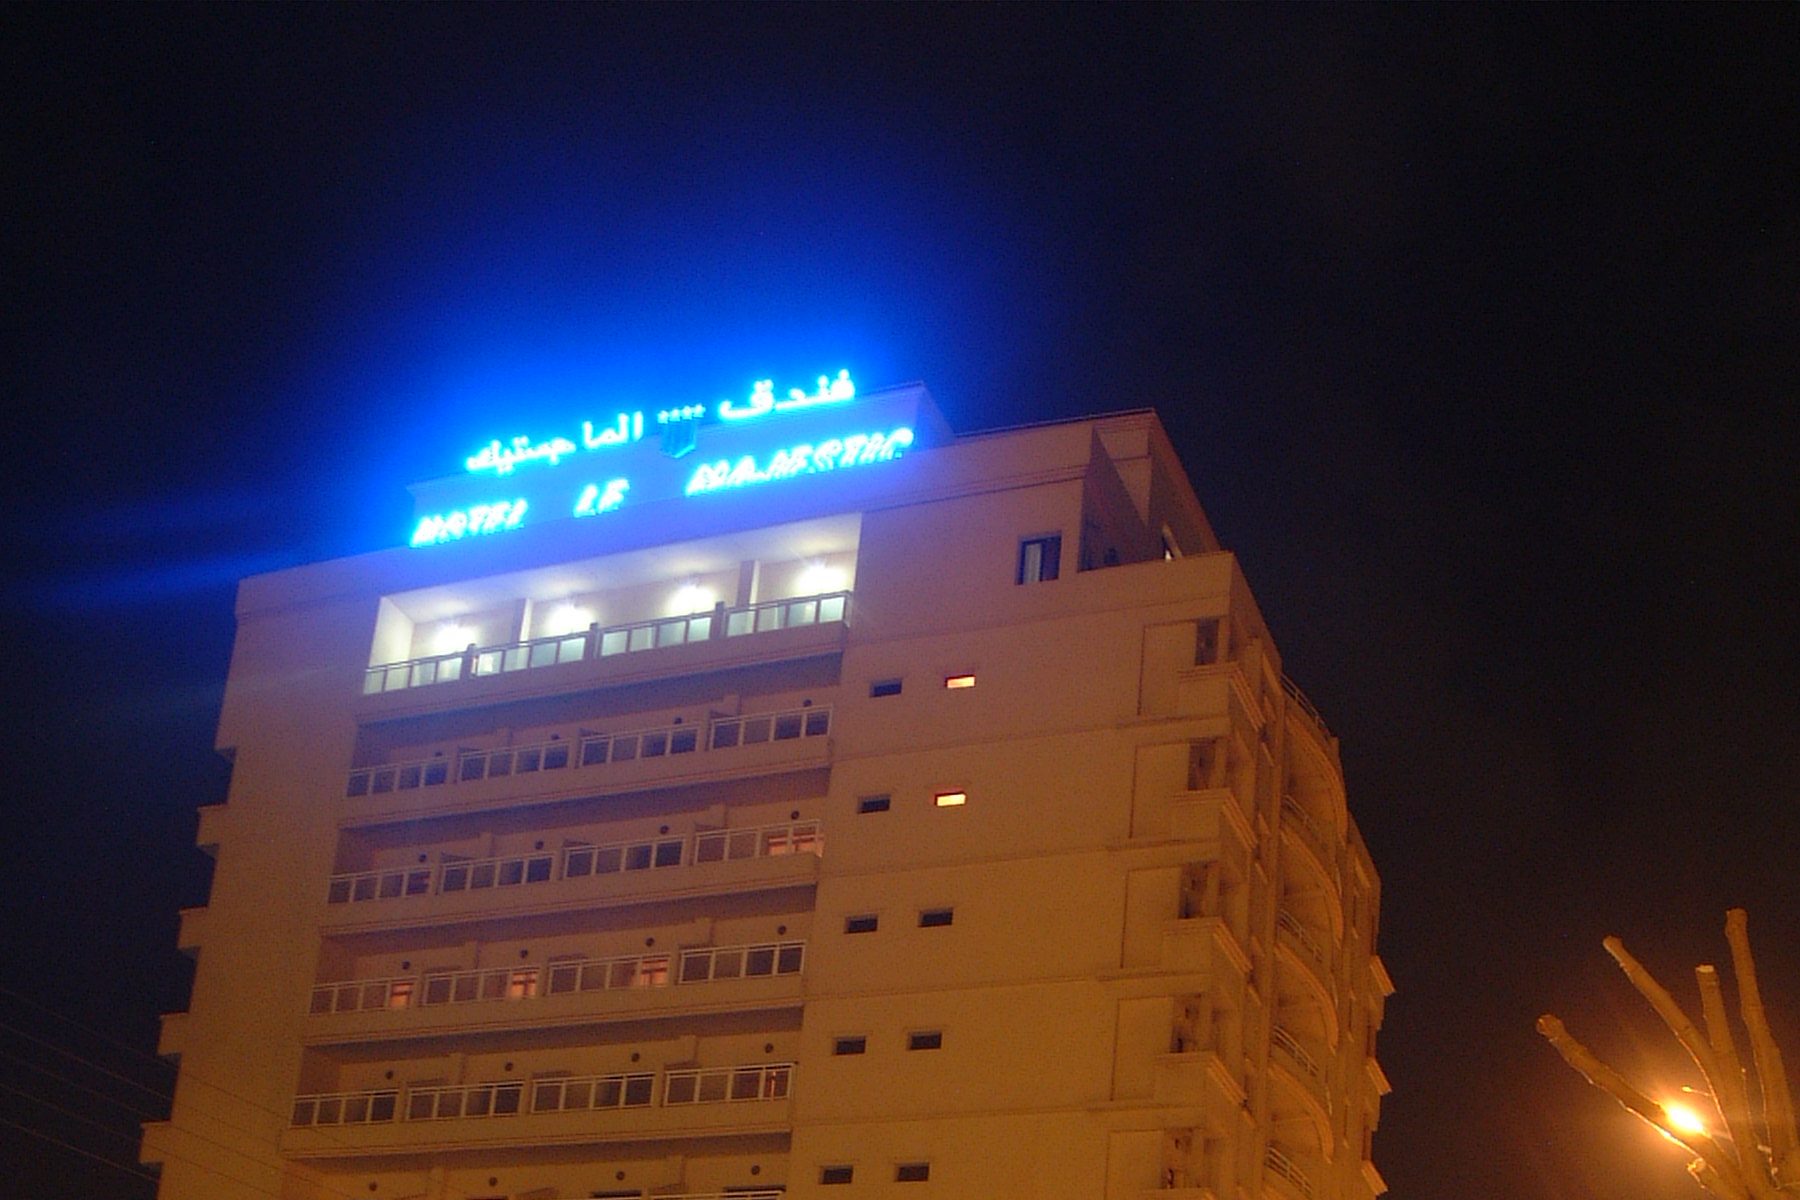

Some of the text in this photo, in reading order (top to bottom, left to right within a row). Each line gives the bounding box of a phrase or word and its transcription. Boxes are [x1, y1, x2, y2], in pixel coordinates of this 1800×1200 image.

[719, 369, 855, 419] فندق
[411, 497, 529, 547] HOTEL
[574, 477, 631, 515] LE
